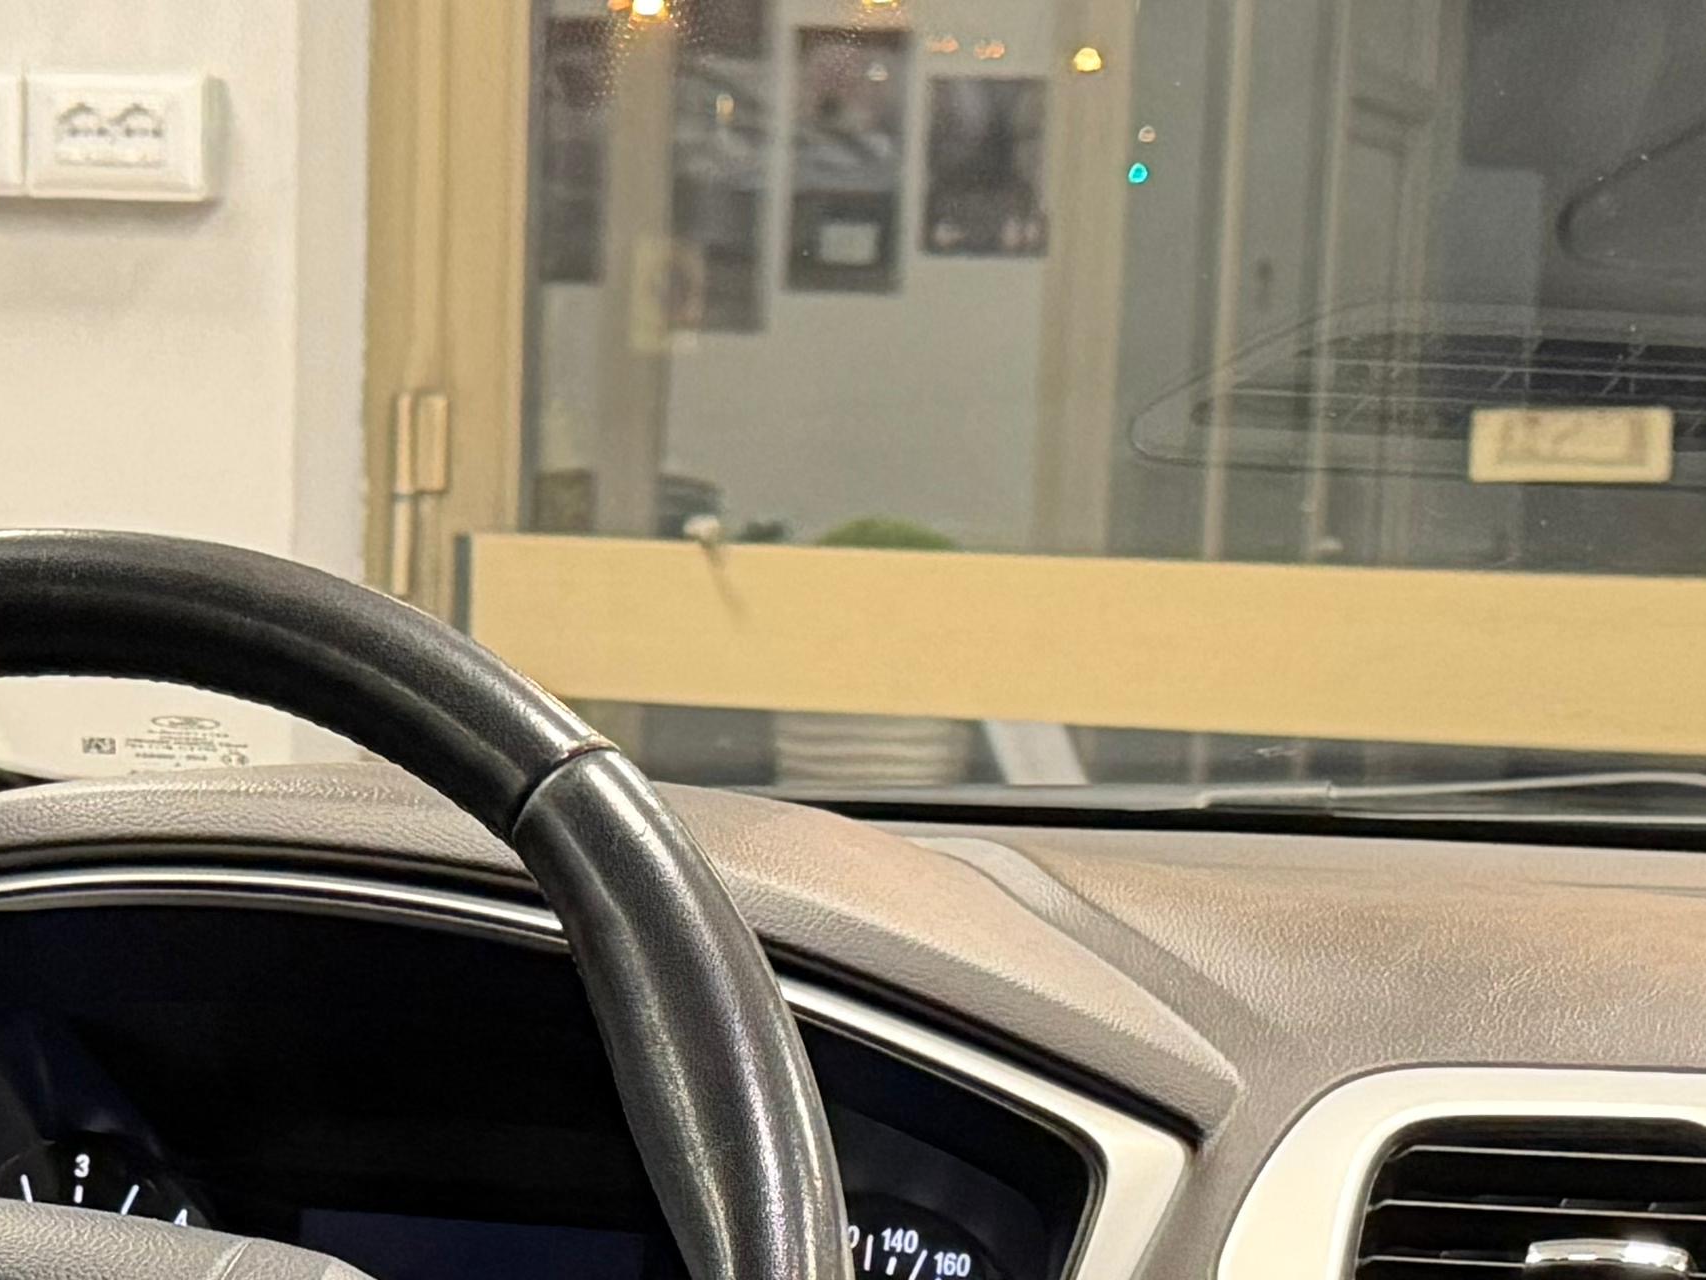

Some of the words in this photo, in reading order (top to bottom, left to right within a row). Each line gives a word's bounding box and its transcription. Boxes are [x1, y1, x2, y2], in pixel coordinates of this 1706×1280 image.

[73, 1153, 91, 1179] 3
[881, 1228, 918, 1254] 140
[934, 1252, 972, 1278] 160
